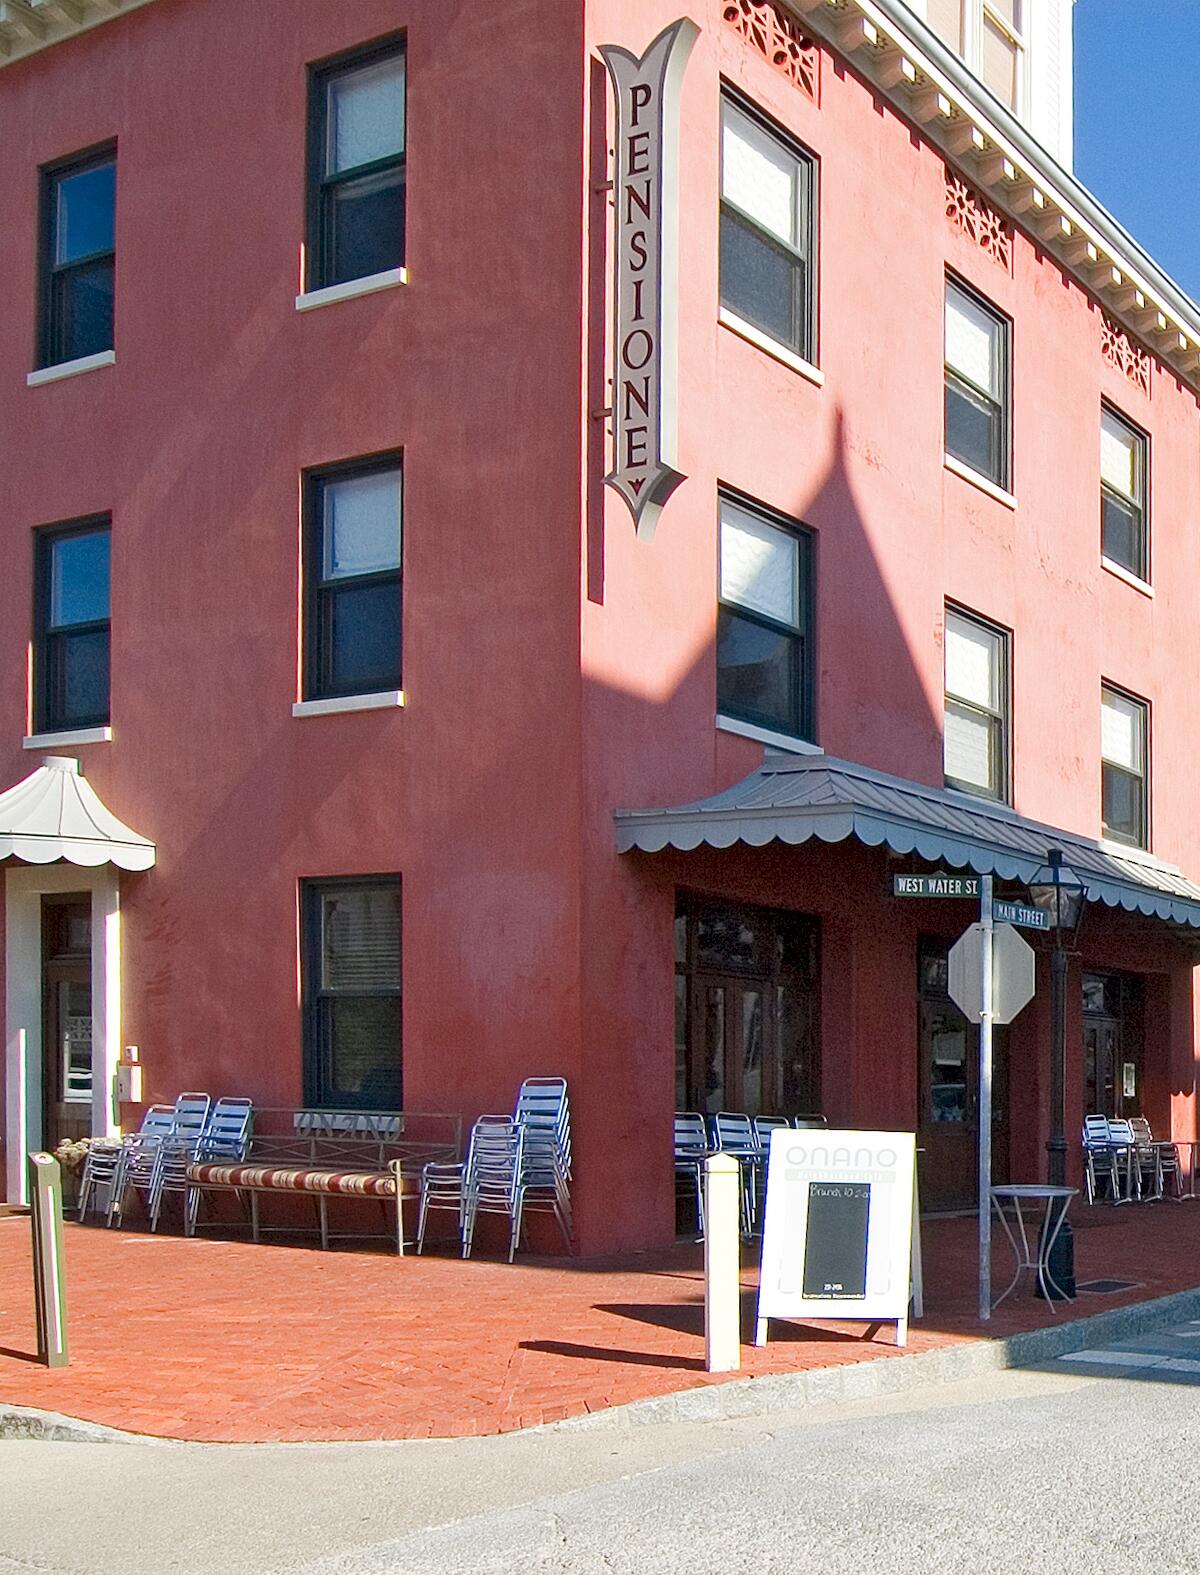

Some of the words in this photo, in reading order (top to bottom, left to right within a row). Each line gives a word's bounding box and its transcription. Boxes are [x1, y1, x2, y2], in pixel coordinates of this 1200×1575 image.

[622, 82, 654, 470] PENSIONE
[898, 878, 924, 892] WEST
[928, 878, 962, 894] WATER
[998, 906, 1016, 921] MAIN
[1018, 909, 1044, 926] STREET
[786, 1146, 898, 1168] ONANO
